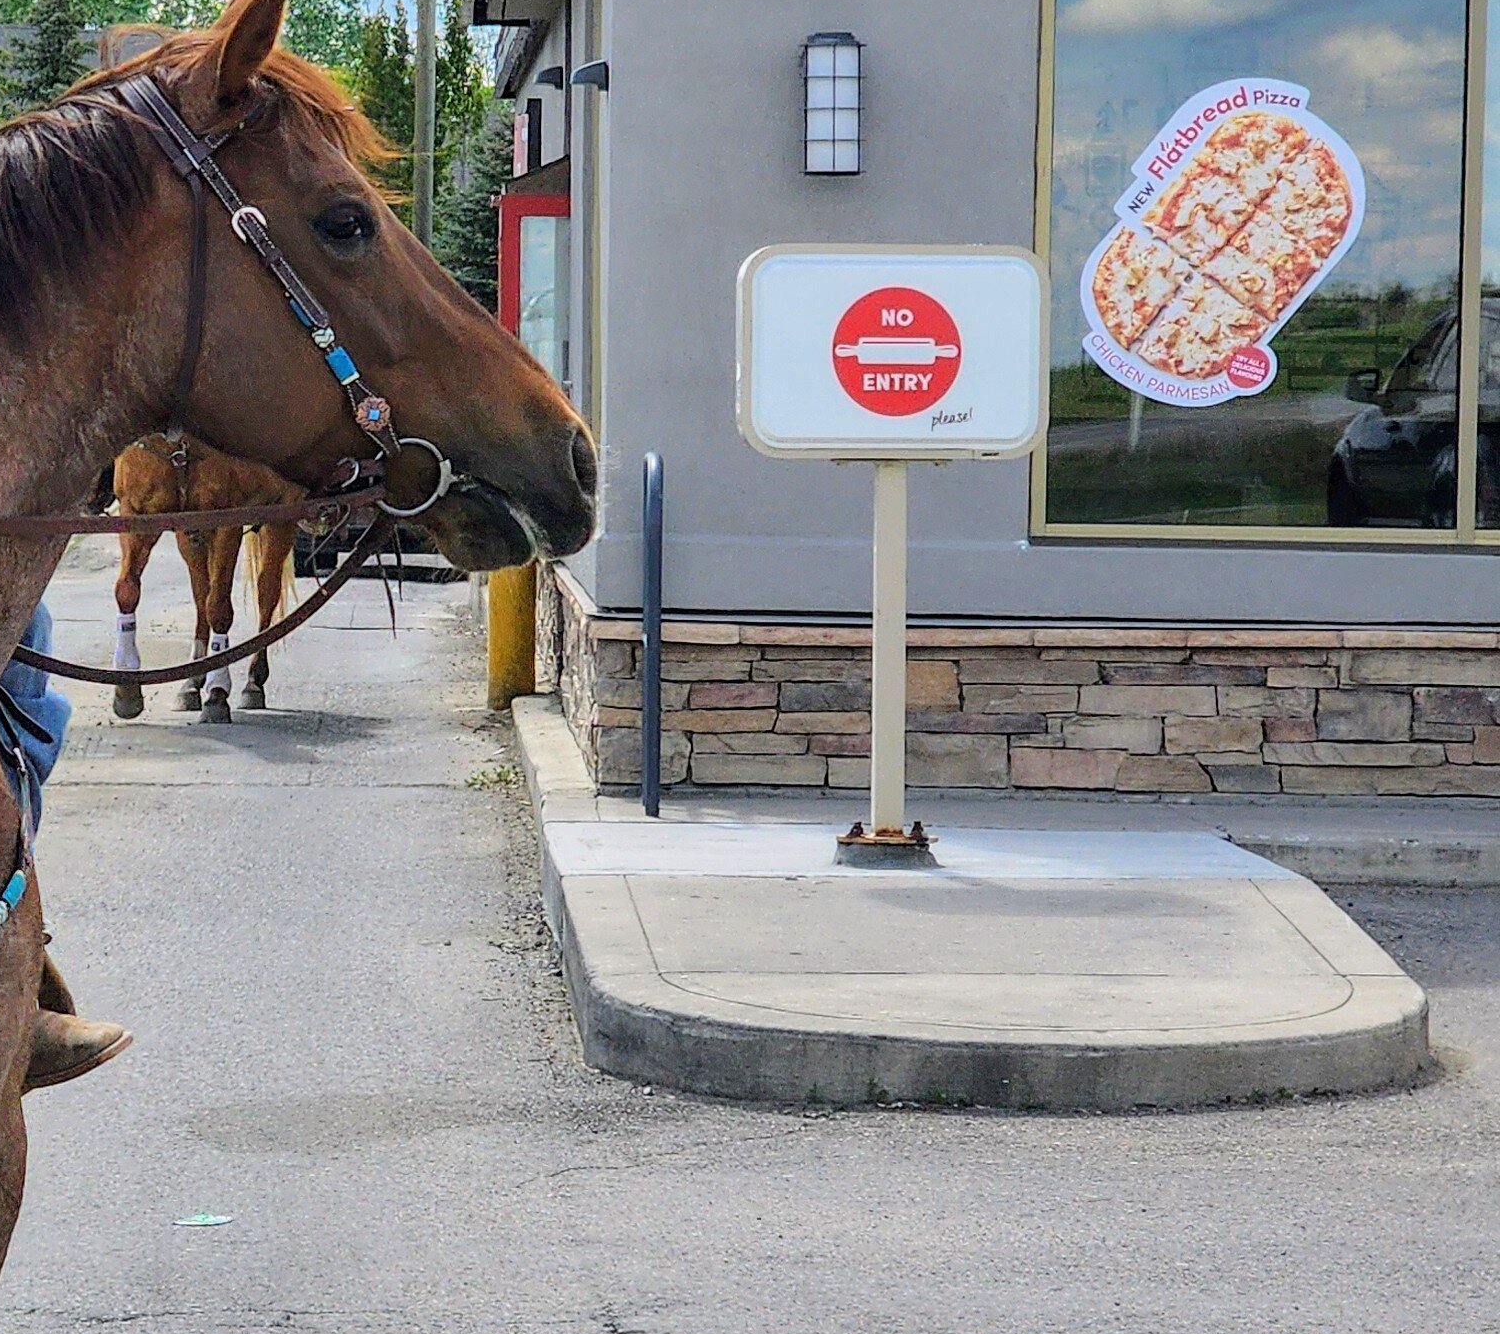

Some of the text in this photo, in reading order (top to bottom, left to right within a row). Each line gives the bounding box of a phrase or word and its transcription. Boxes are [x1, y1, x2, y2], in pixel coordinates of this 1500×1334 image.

[1128, 86, 1301, 213] NEW Flatbread Pizza
[881, 308, 914, 327] NO
[1090, 334, 1231, 401] CHICKEN PARMESAN
[863, 373, 933, 391] ENTRY
[931, 408, 973, 431] please!
